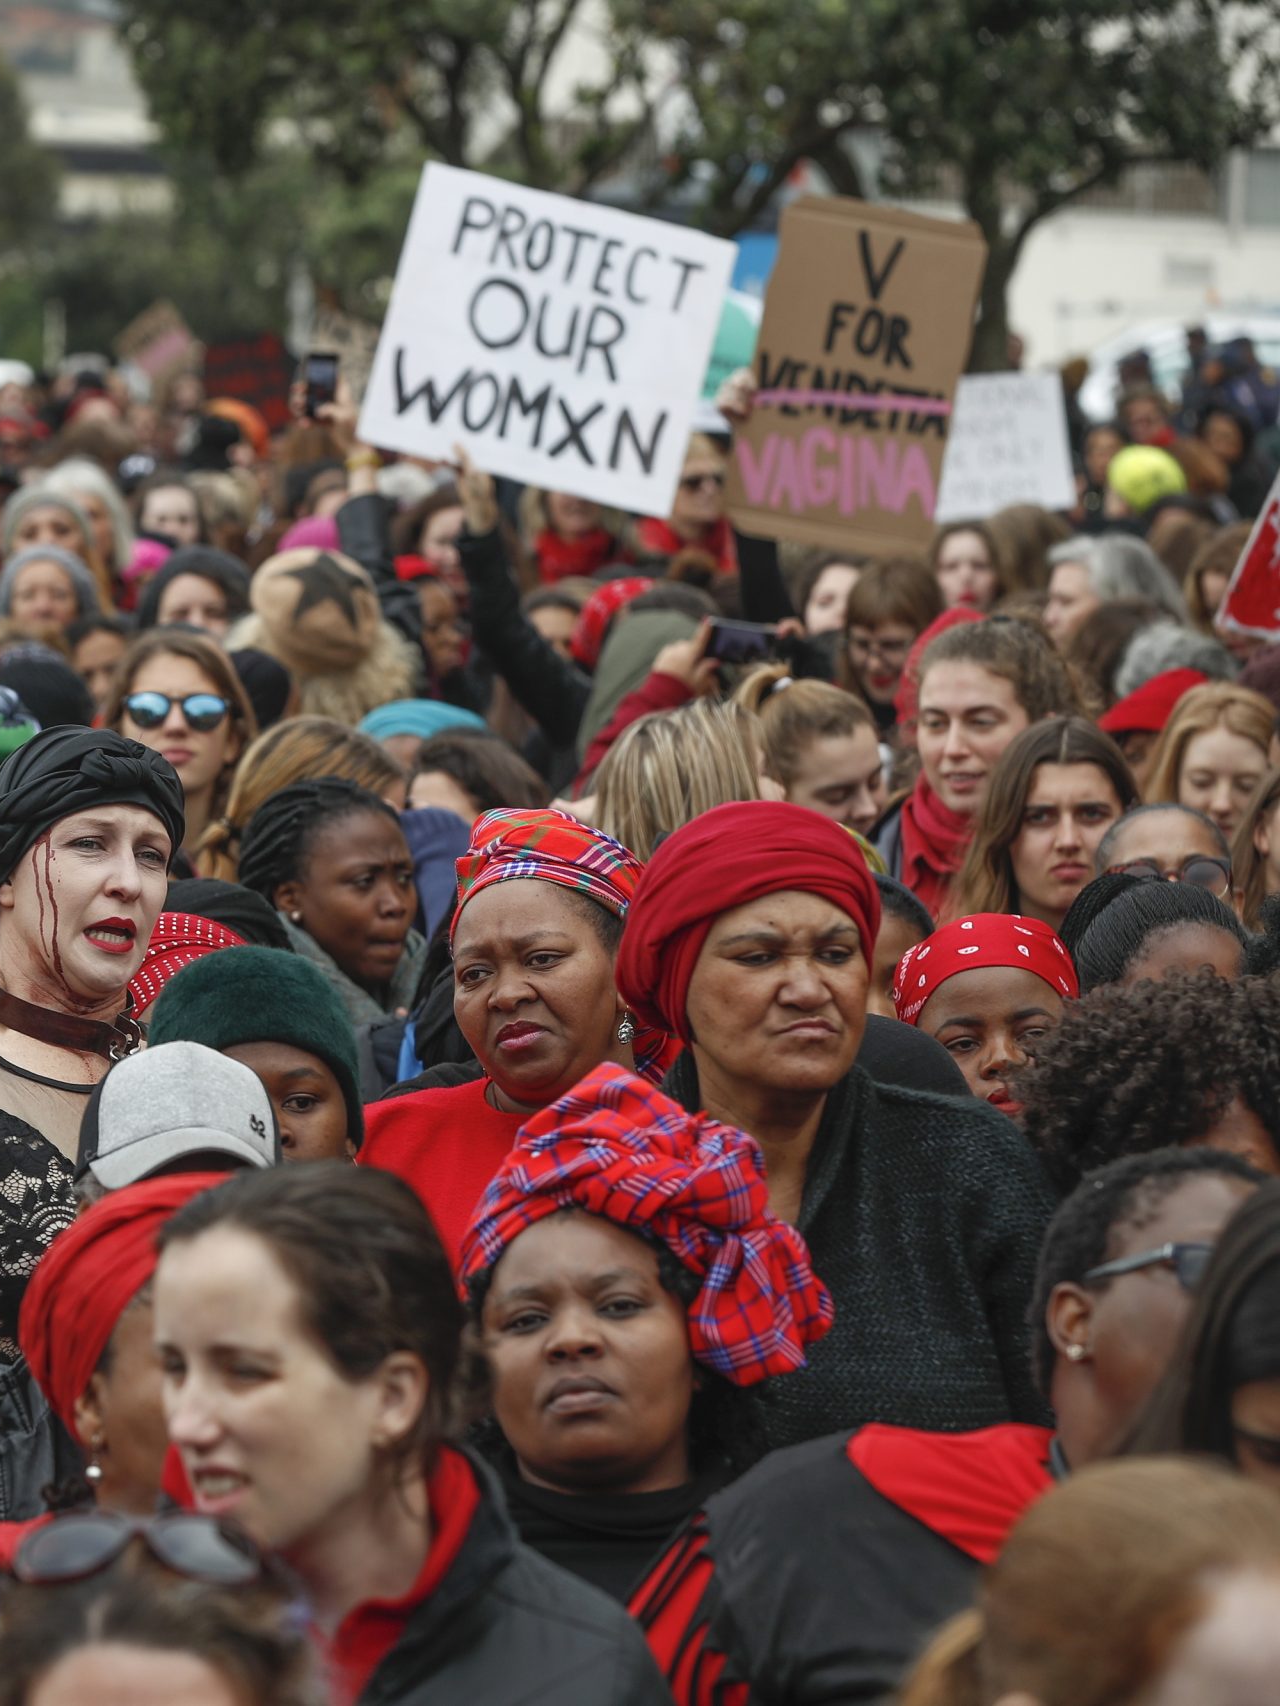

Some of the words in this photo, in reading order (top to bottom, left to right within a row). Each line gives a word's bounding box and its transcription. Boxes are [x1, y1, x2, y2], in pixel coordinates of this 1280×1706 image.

[451, 196, 706, 313] PROTECT
[858, 229, 905, 301] V
[469, 277, 626, 383] OUR
[824, 301, 913, 370] FOR
[393, 345, 669, 477] WOMXN
[757, 351, 949, 438] VENDETTA
[735, 424, 936, 523] VAGINA
